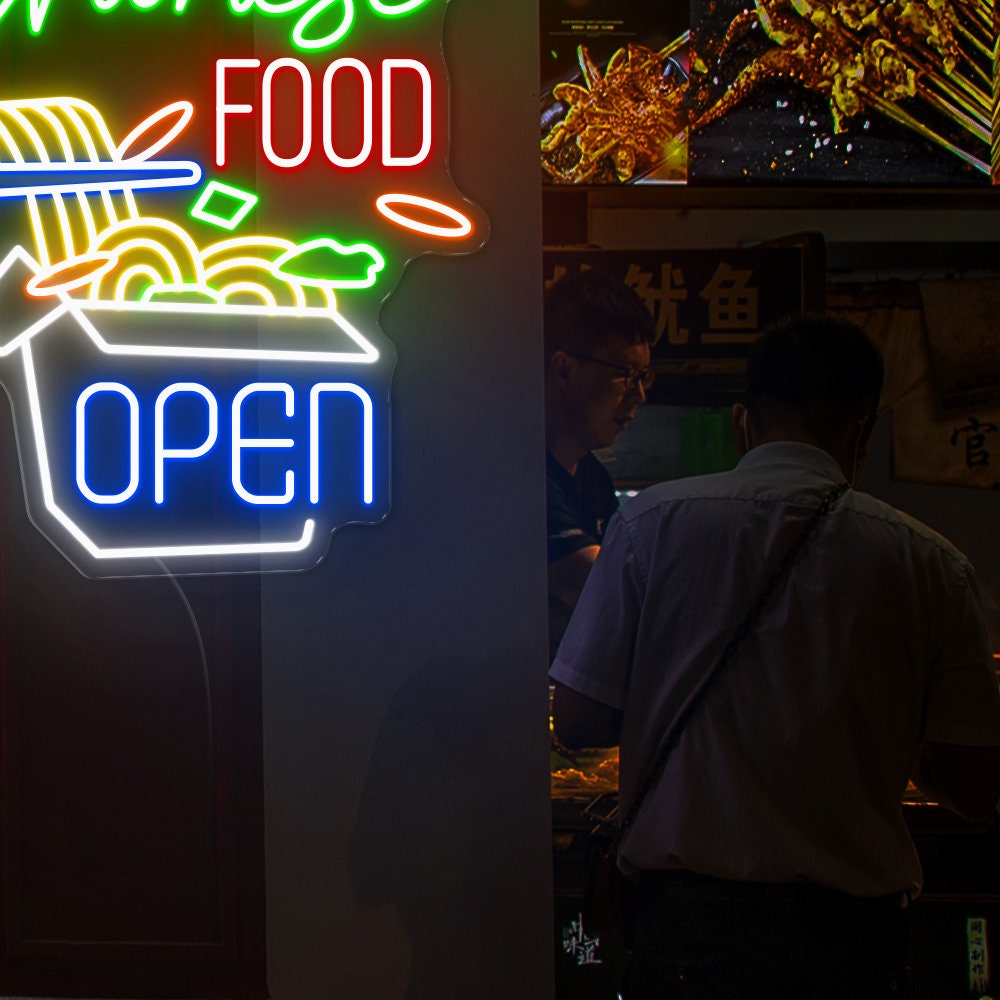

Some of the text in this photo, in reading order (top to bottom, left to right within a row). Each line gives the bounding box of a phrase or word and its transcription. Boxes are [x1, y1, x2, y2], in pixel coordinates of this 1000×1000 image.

[215, 57, 433, 168] FOOD
[74, 381, 374, 506] OPEN
[950, 417, 1000, 469] 官
